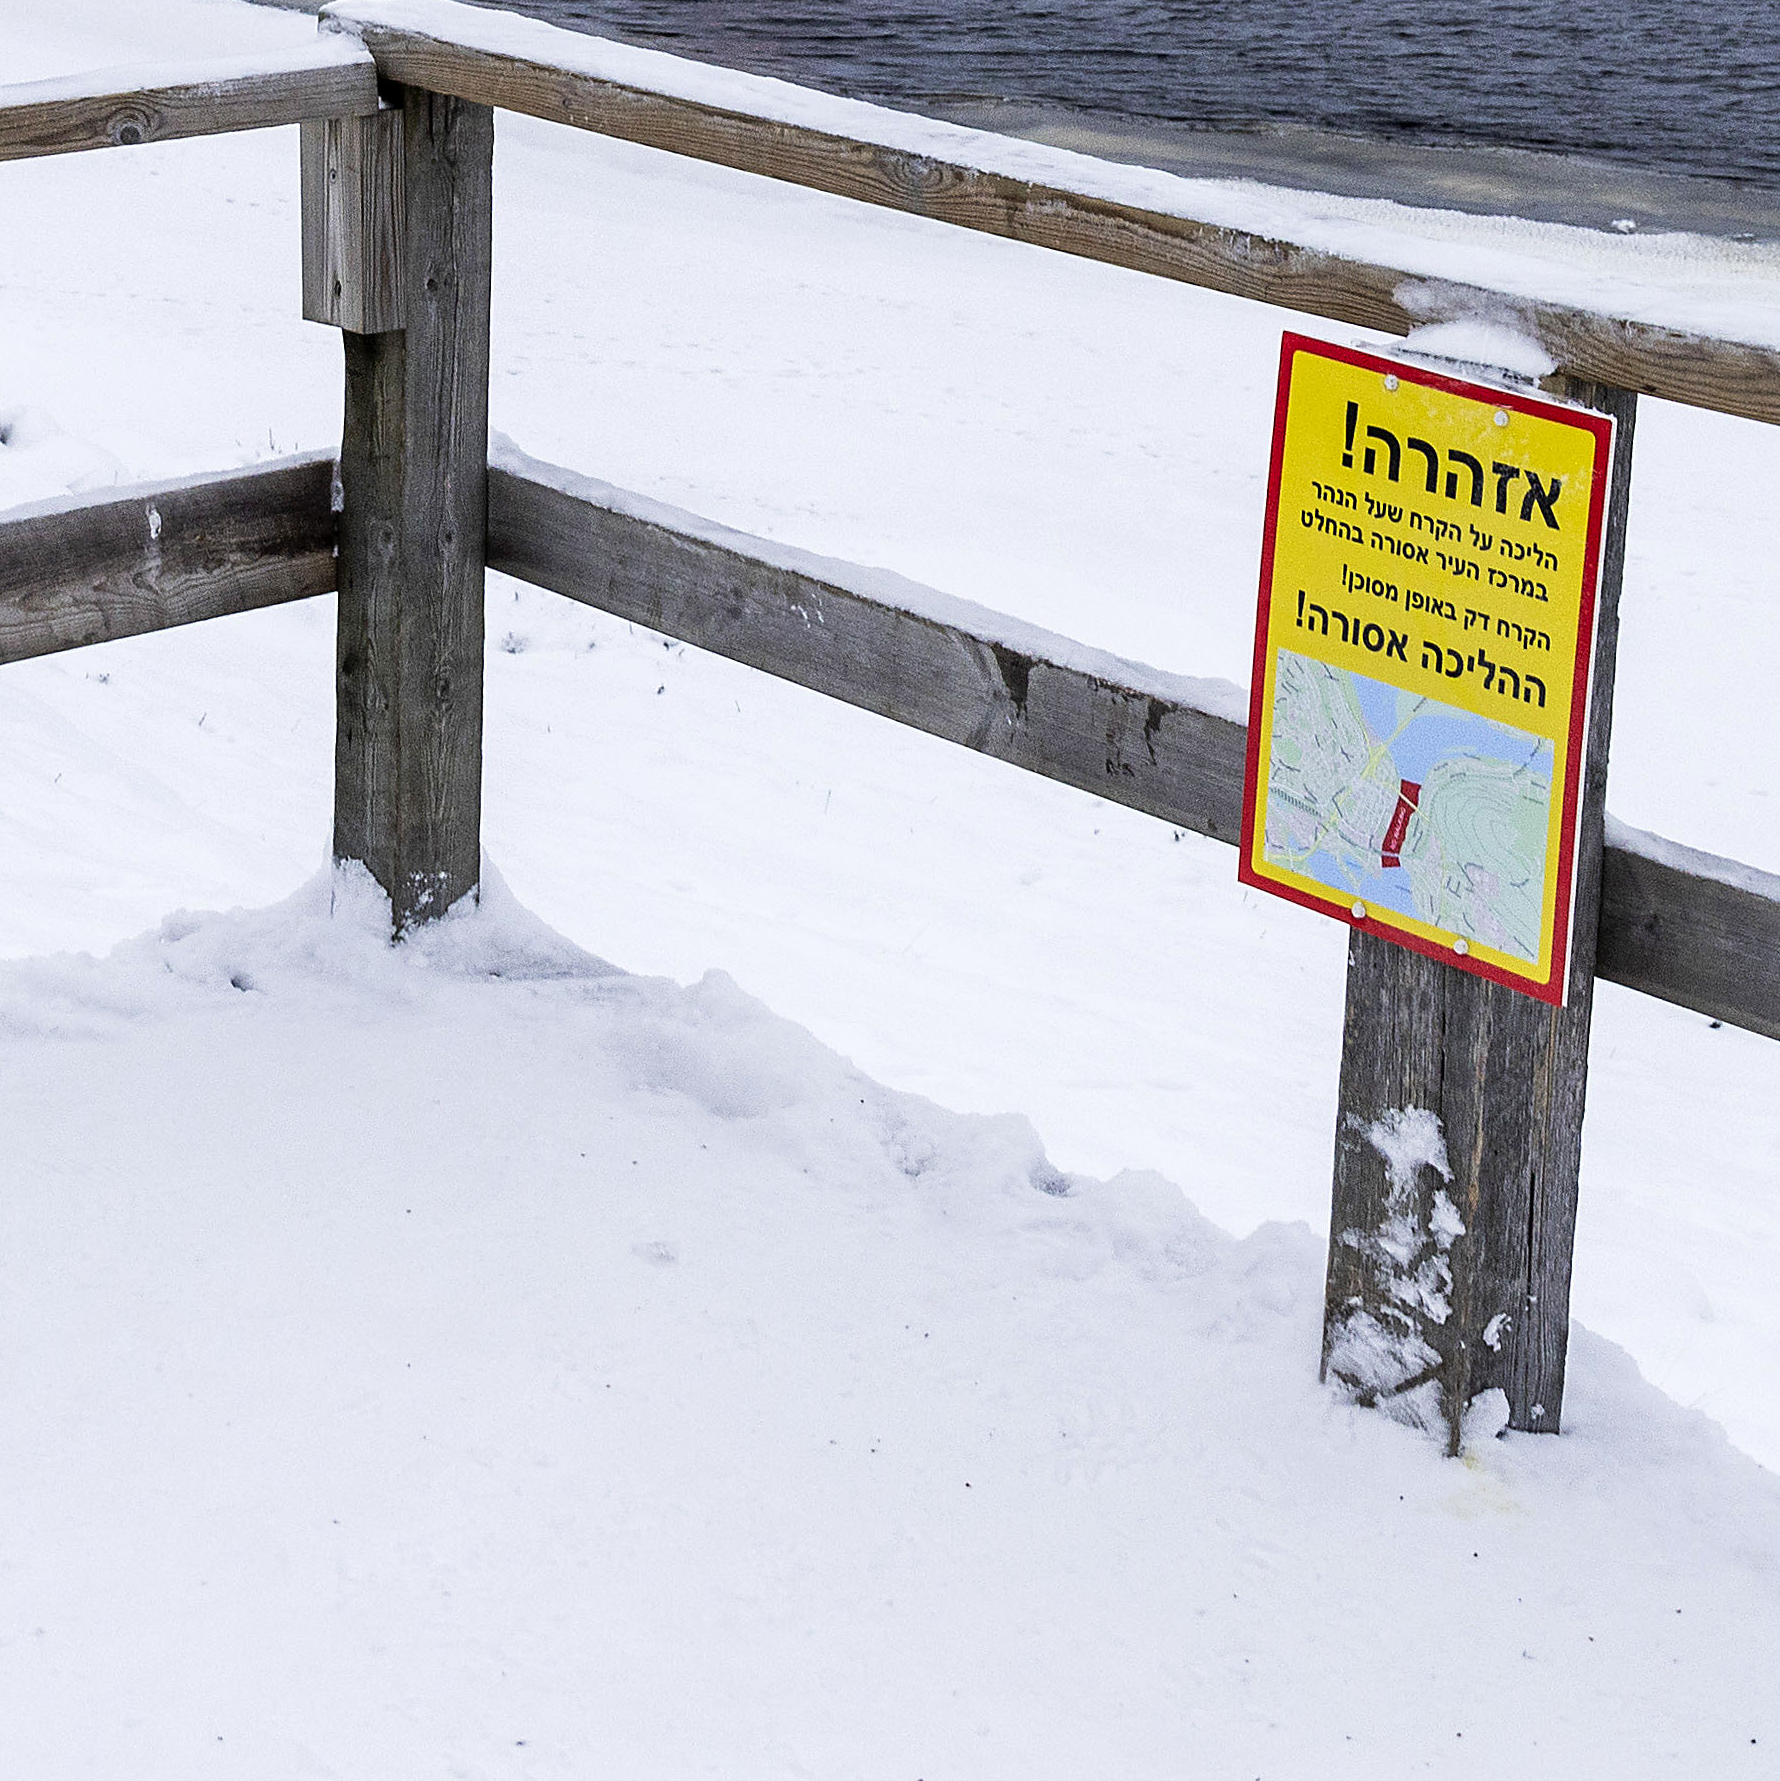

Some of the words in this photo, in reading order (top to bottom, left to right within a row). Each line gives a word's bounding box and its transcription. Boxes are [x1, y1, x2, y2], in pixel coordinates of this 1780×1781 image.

[1341, 400, 1562, 531] אזהרה!
[1311, 480, 1357, 510] הנהר
[1364, 491, 1403, 523] שעל
[1301, 508, 1364, 545] בהחלט
[1409, 511, 1462, 542] הקרח
[1469, 523, 1493, 551] על
[1370, 531, 1429, 565] אסורה
[1500, 538, 1558, 572] הליכה
[1341, 563, 1399, 602] מסוכן!
[1435, 551, 1480, 581] העיר
[1487, 567, 1549, 602] במרכז
[1404, 589, 1457, 621] באופן
[1463, 608, 1491, 631] דק
[1296, 589, 1408, 663] אסורה!
[1496, 618, 1551, 652] הקרח
[1421, 640, 1547, 708] ההליכה
